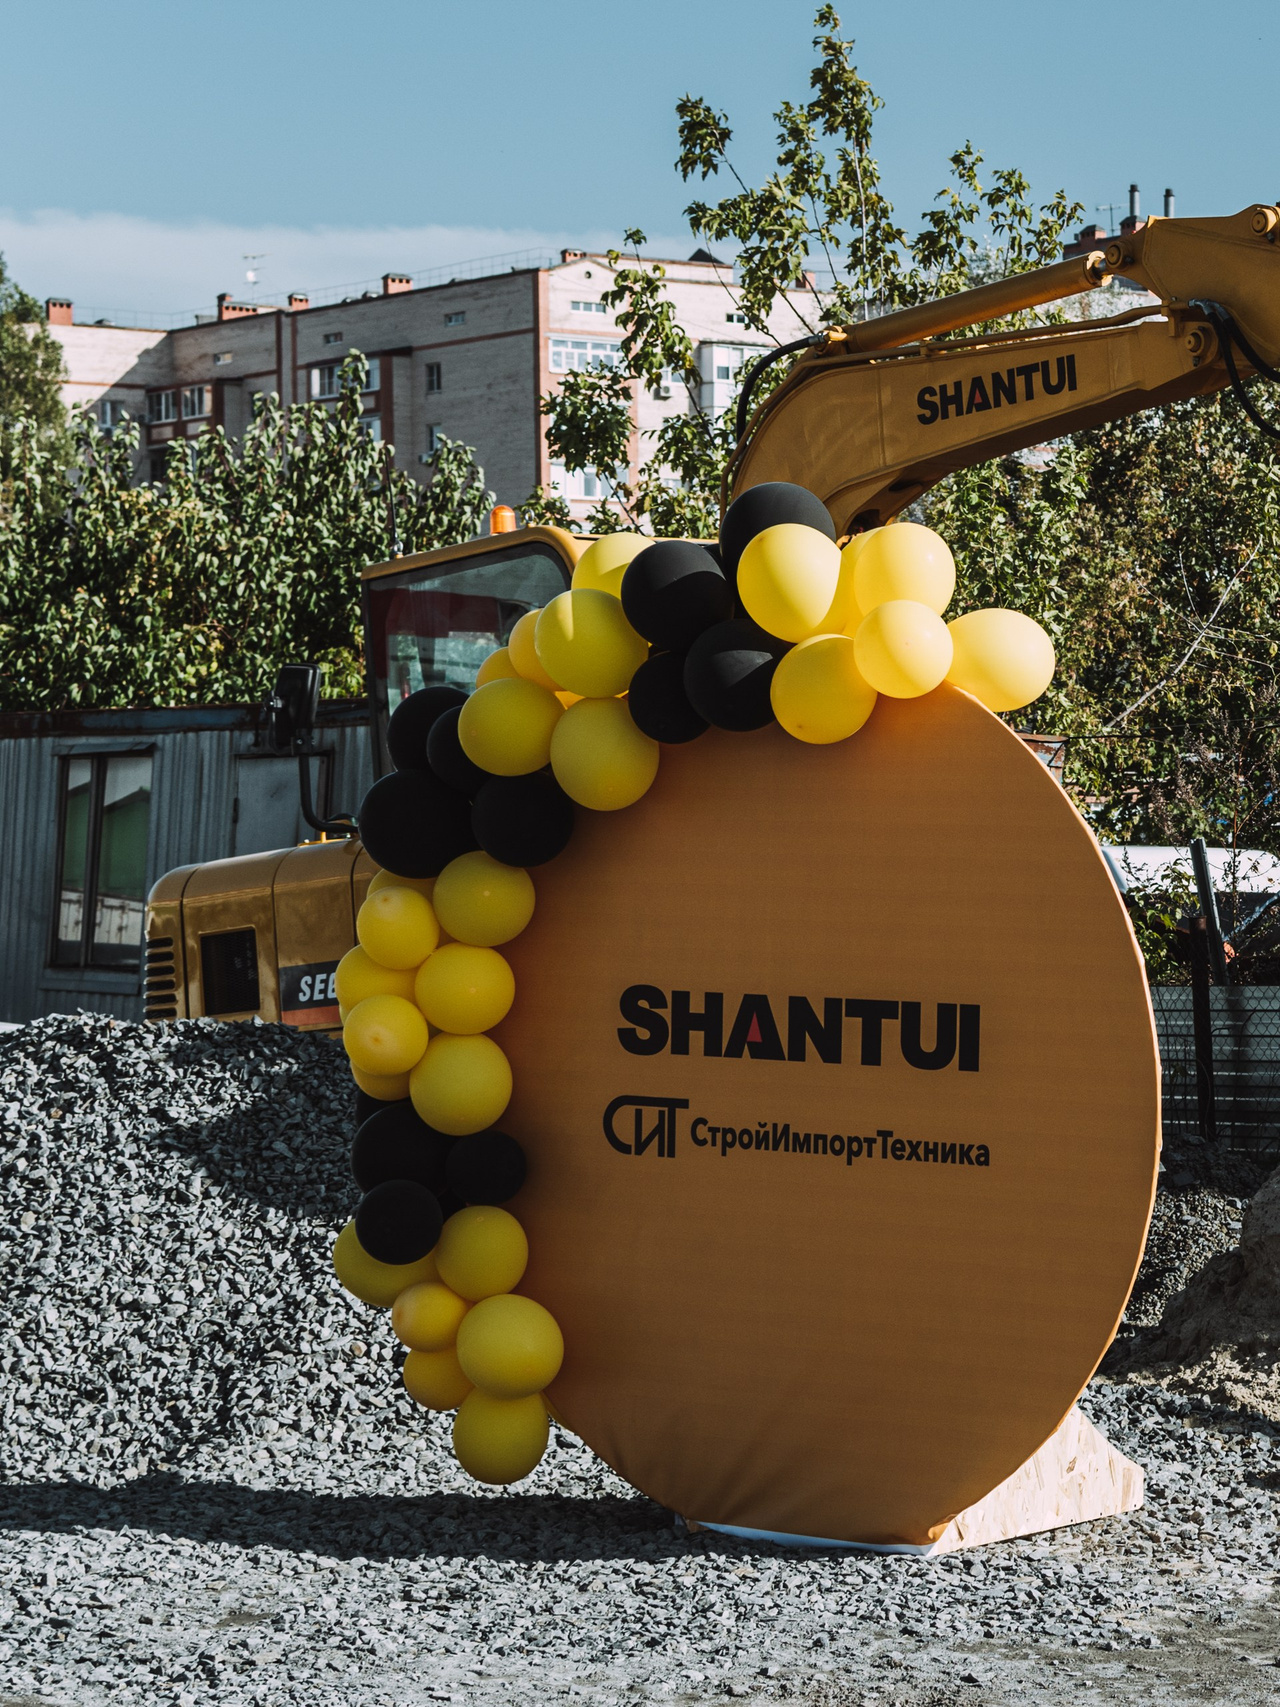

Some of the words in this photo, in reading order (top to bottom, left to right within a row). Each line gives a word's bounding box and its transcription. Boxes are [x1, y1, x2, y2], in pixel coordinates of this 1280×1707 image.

[916, 354, 1078, 425] SHANTUI
[616, 984, 981, 1072] SHANTUI
[602, 1095, 690, 1158] СИТ
[690, 1117, 991, 1166] СтройИмпортТехника
